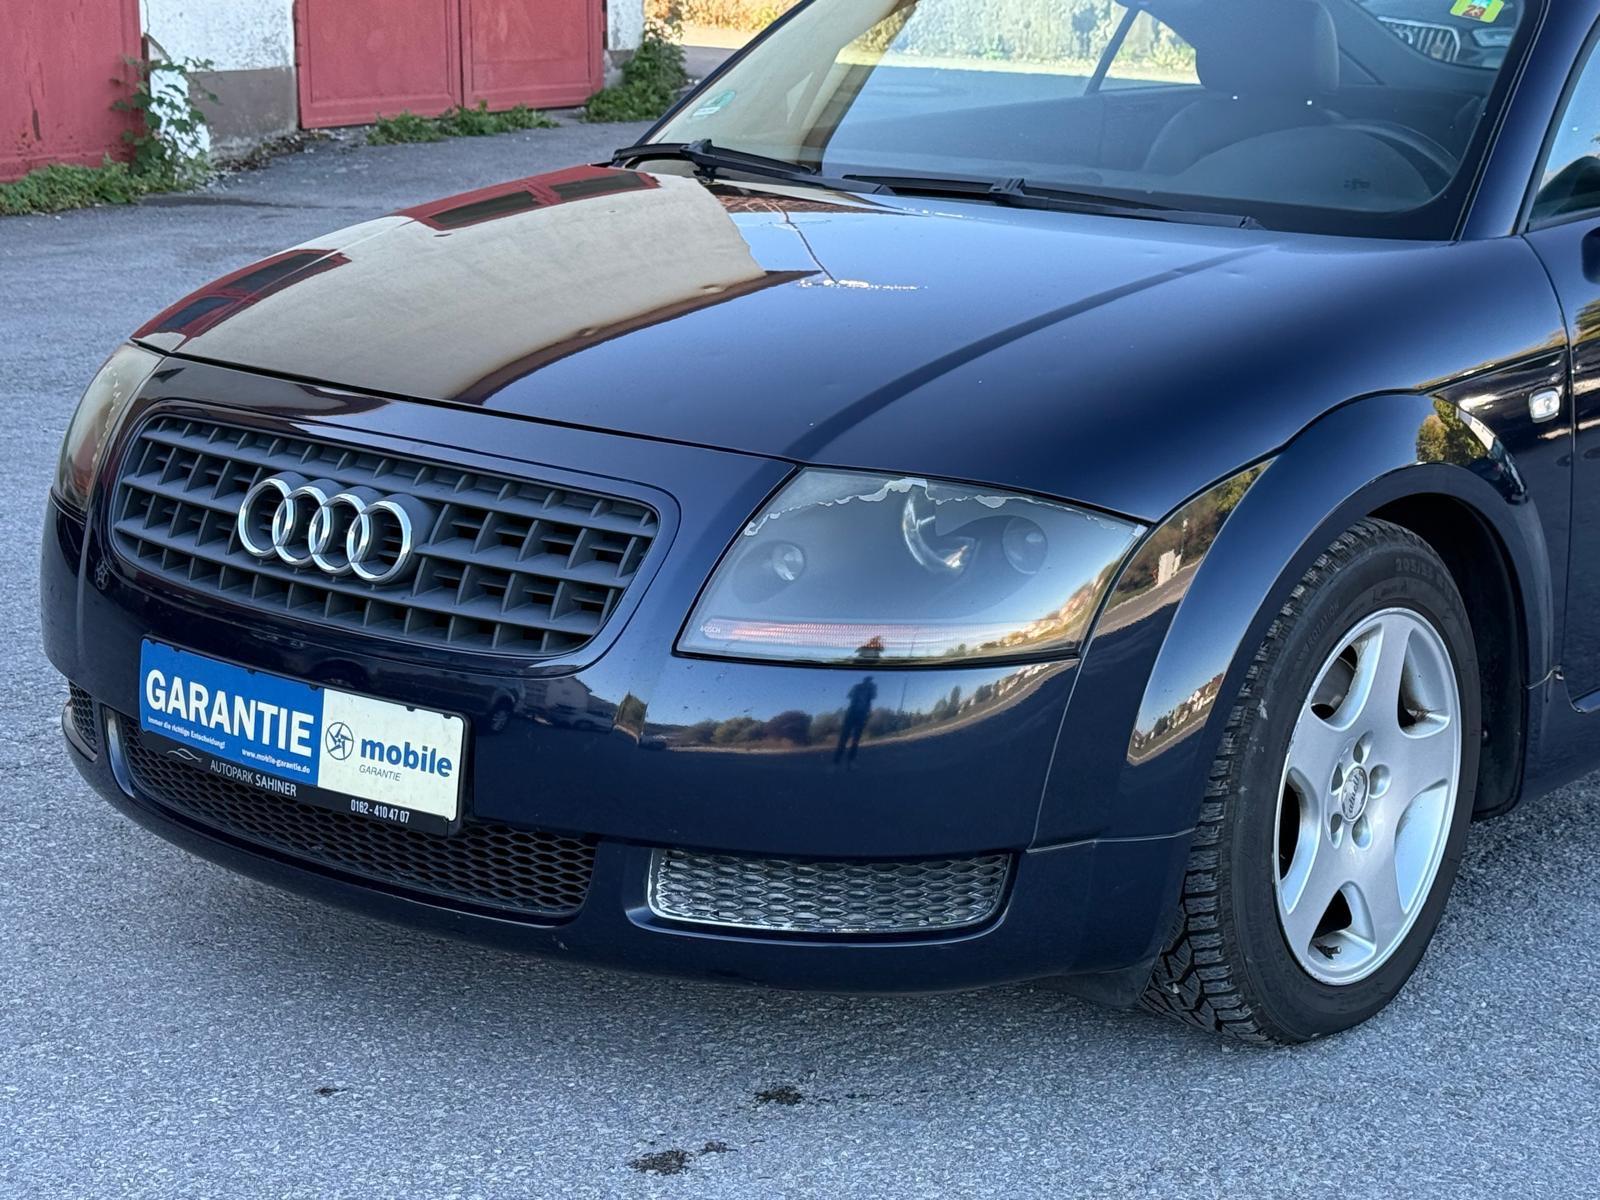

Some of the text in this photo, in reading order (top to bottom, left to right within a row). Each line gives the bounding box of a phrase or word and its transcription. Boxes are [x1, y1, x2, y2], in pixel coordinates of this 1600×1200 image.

[146, 669, 314, 757] GARANTIE
[163, 721, 172, 730] die
[171, 725, 191, 738] richtige
[190, 730, 226, 750] Entscheidung!
[241, 748, 311, 775] www.mobile-garantie.de
[360, 738, 453, 778] mobile
[210, 760, 297, 797] AUTOPARK SAHINER
[359, 764, 402, 782] GARANTIE
[350, 799, 369, 814] 0162
[374, 804, 388, 818] 410
[388, 808, 399, 821] 47
[400, 810, 410, 823] 07
